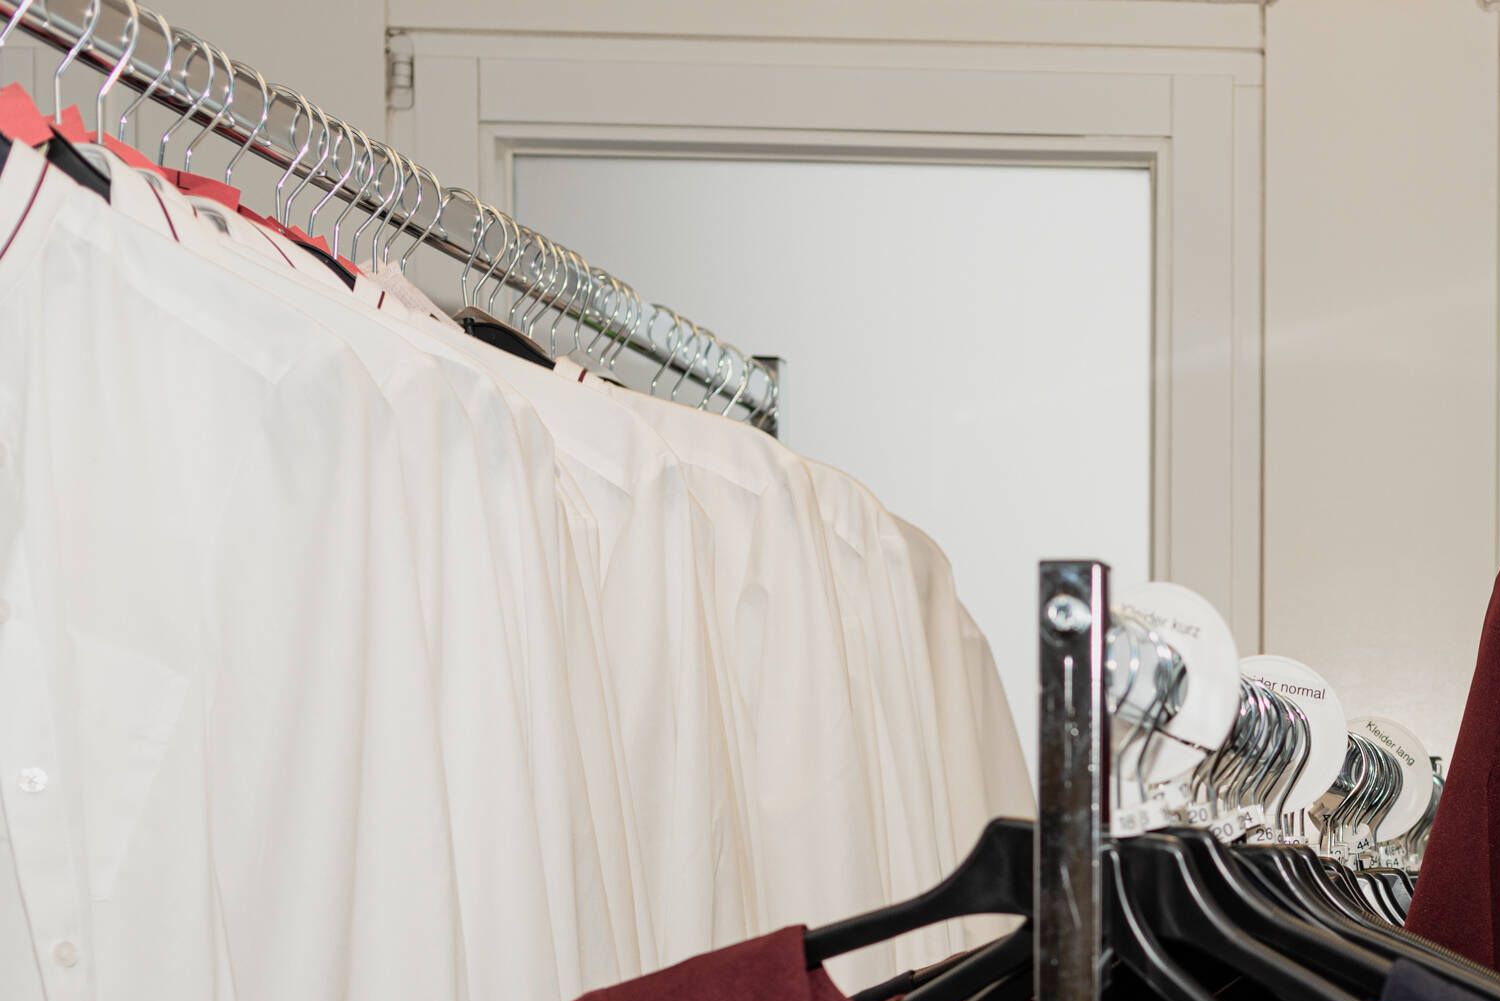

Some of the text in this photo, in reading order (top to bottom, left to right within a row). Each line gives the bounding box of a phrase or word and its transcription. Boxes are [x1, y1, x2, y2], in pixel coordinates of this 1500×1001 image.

[1280, 683, 1326, 700] normal
[1366, 720, 1415, 767] Kleider lang
[1187, 807, 1208, 824] 20
[1256, 827, 1273, 842] 26
[1357, 838, 1369, 850] 44
